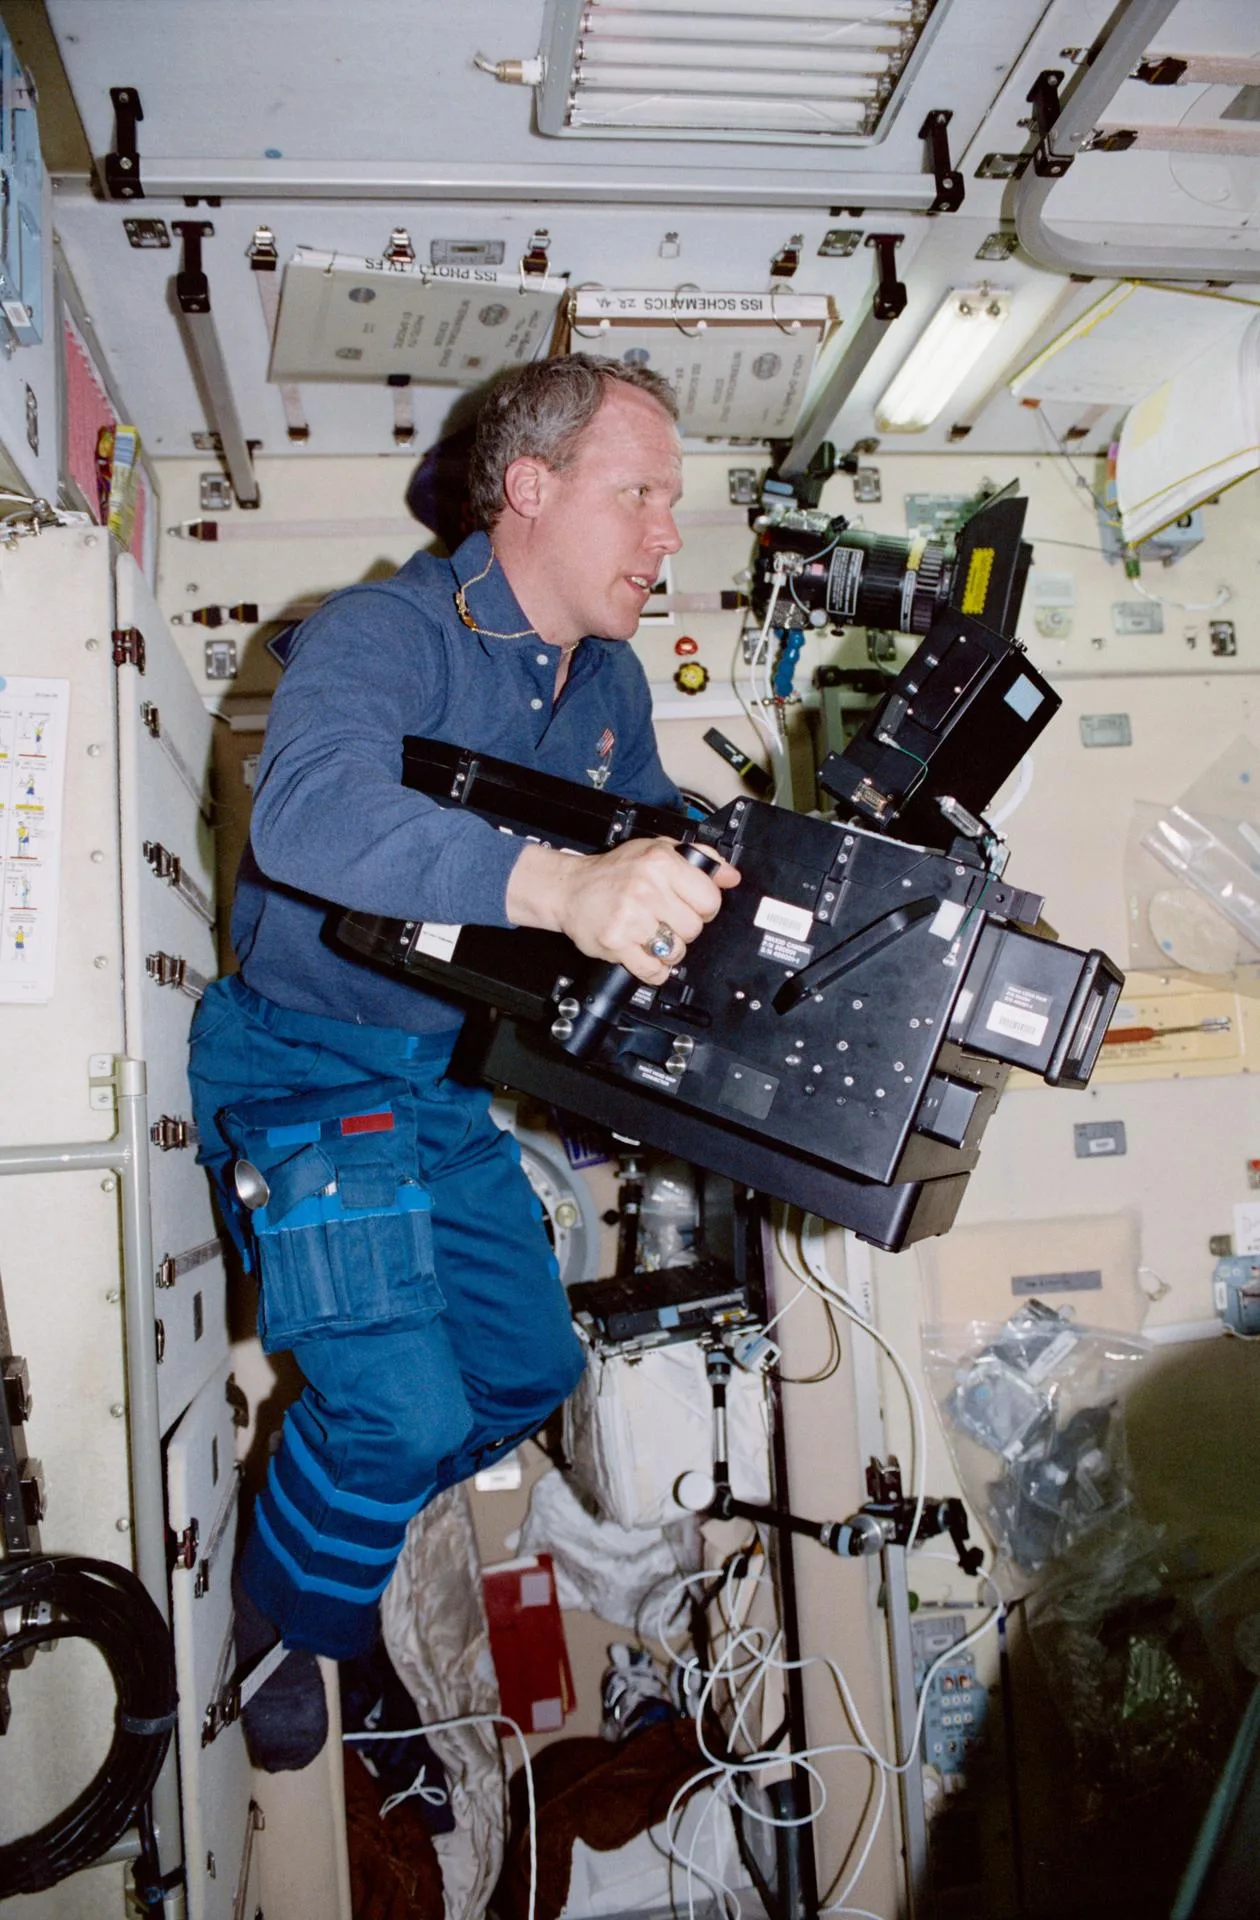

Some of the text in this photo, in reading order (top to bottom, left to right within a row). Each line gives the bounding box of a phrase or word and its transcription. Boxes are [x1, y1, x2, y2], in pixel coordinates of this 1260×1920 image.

[474, 270, 498, 282] ISS
[644, 297, 763, 311] ISS SCHEMATICS
